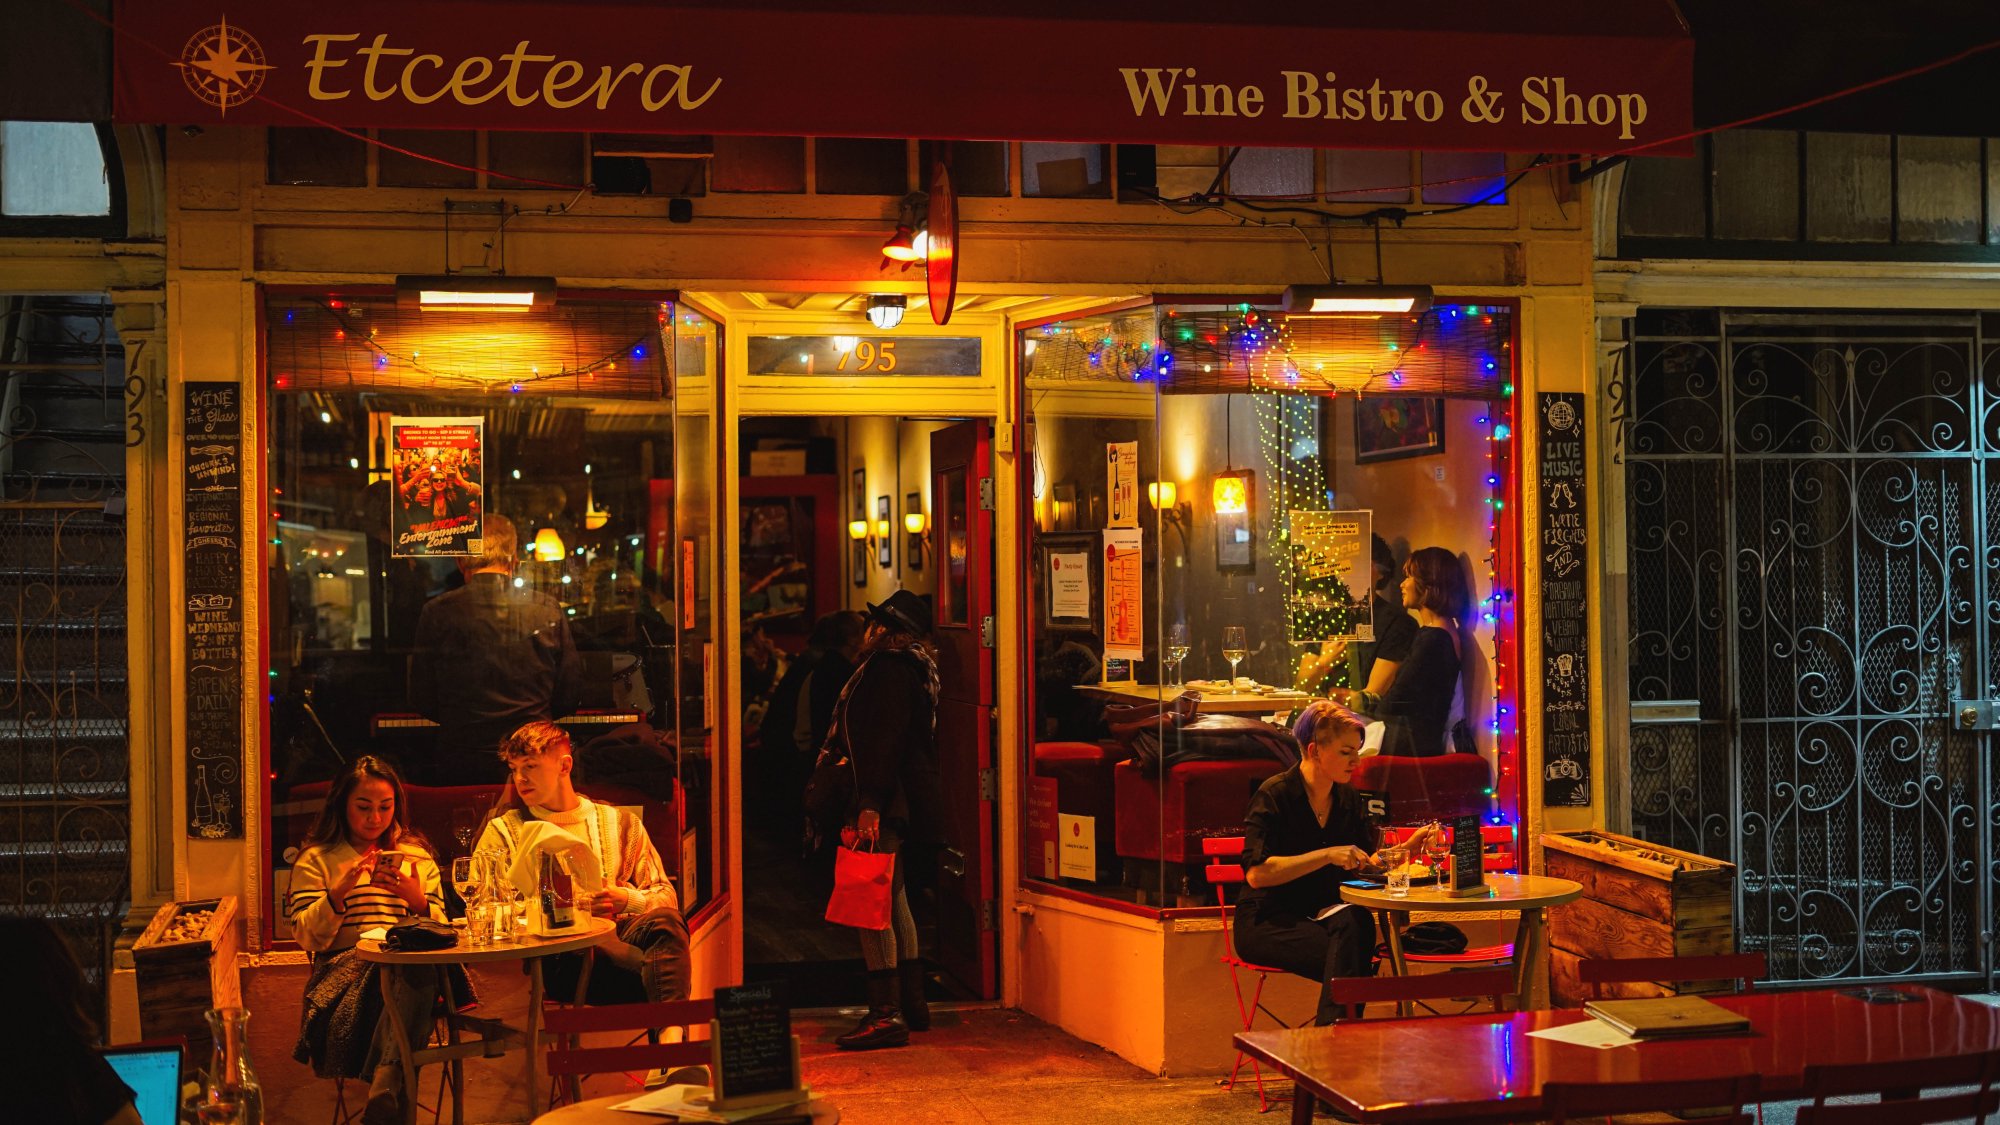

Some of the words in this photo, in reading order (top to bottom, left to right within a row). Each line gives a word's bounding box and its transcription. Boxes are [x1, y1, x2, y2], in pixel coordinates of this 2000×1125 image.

[302, 32, 723, 112] Etcetera
[1119, 67, 1265, 118] Wine
[1281, 70, 1444, 122] Bistro
[1461, 75, 1505, 124] &
[1521, 76, 1648, 140] Shop
[125, 339, 147, 448] 793
[190, 388, 234, 409] WINE
[186, 416, 203, 424] THE
[1545, 441, 1581, 460] LIVE
[196, 463, 236, 480] UNWIND!
[1542, 461, 1584, 477] MUSIC
[189, 511, 233, 522] REGIONAL
[1549, 513, 1580, 528] WINE
[399, 520, 478, 544] Entertainment
[1544, 528, 1587, 546] FLIGHTS
[426, 536, 453, 548] Zone
[195, 551, 229, 564] HAPPY
[1553, 551, 1573, 572] AND
[195, 565, 226, 577] HOUR
[1549, 580, 1582, 600] ORGANIC
[194, 610, 229, 622] WINE
[1544, 600, 1583, 620] NATURAL
[187, 622, 241, 635] WEDNESDAY
[1551, 620, 1580, 636] VEGAN
[216, 634, 236, 646] OFF
[191, 647, 238, 660] BOTTLES
[198, 676, 229, 694] OPEN
[197, 694, 233, 711] DAILY
[1552, 712, 1580, 732] LOCAL
[1548, 730, 1589, 755] ARTISTS
[729, 986, 772, 1003] Specials
